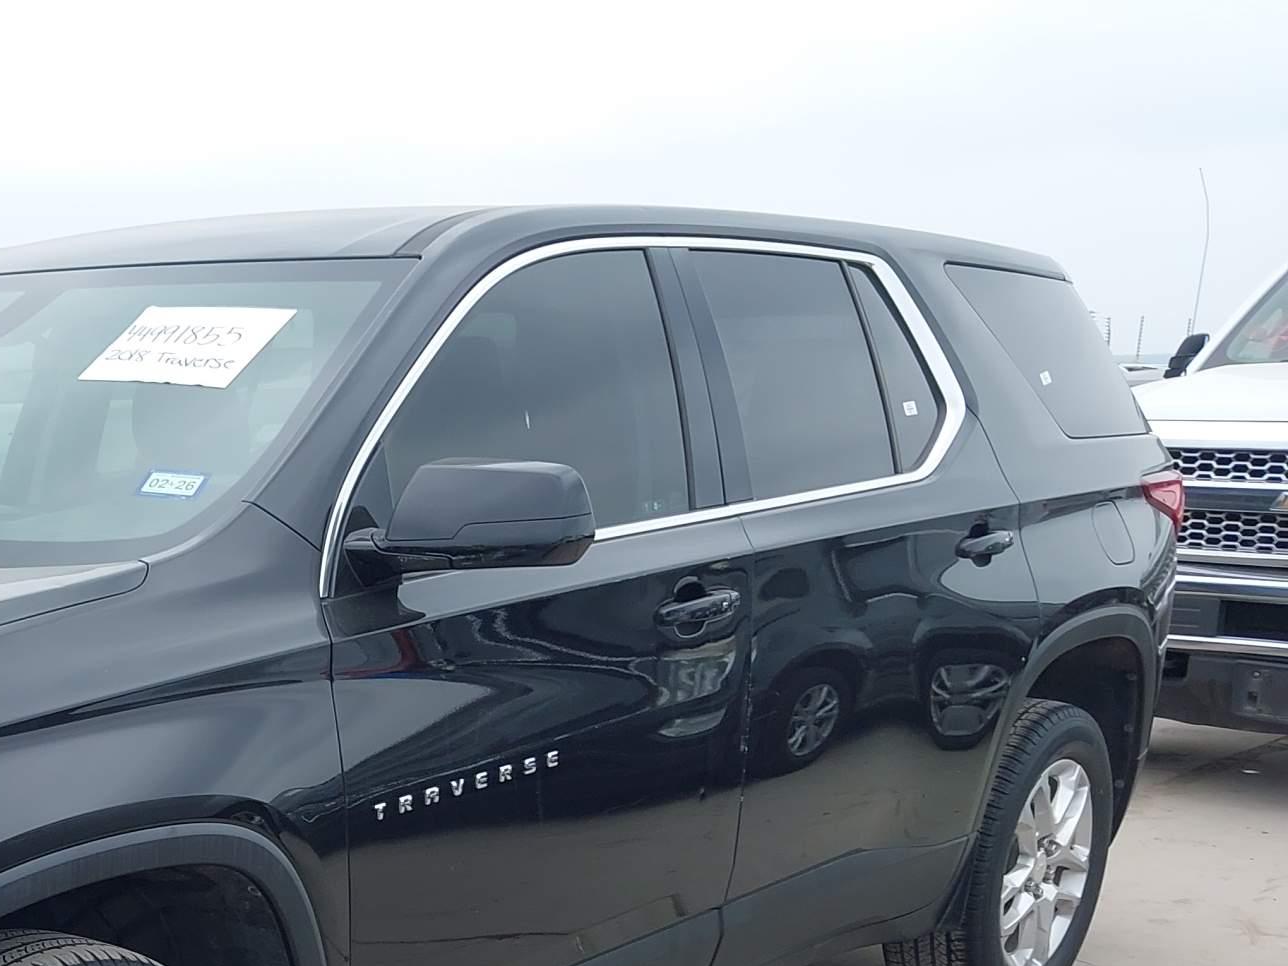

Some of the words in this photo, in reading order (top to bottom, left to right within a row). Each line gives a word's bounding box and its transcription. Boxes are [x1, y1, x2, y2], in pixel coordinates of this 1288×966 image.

[127, 324, 244, 347] 44991855
[158, 352, 236, 369] Traverse
[374, 750, 560, 821] TRAVERSE
